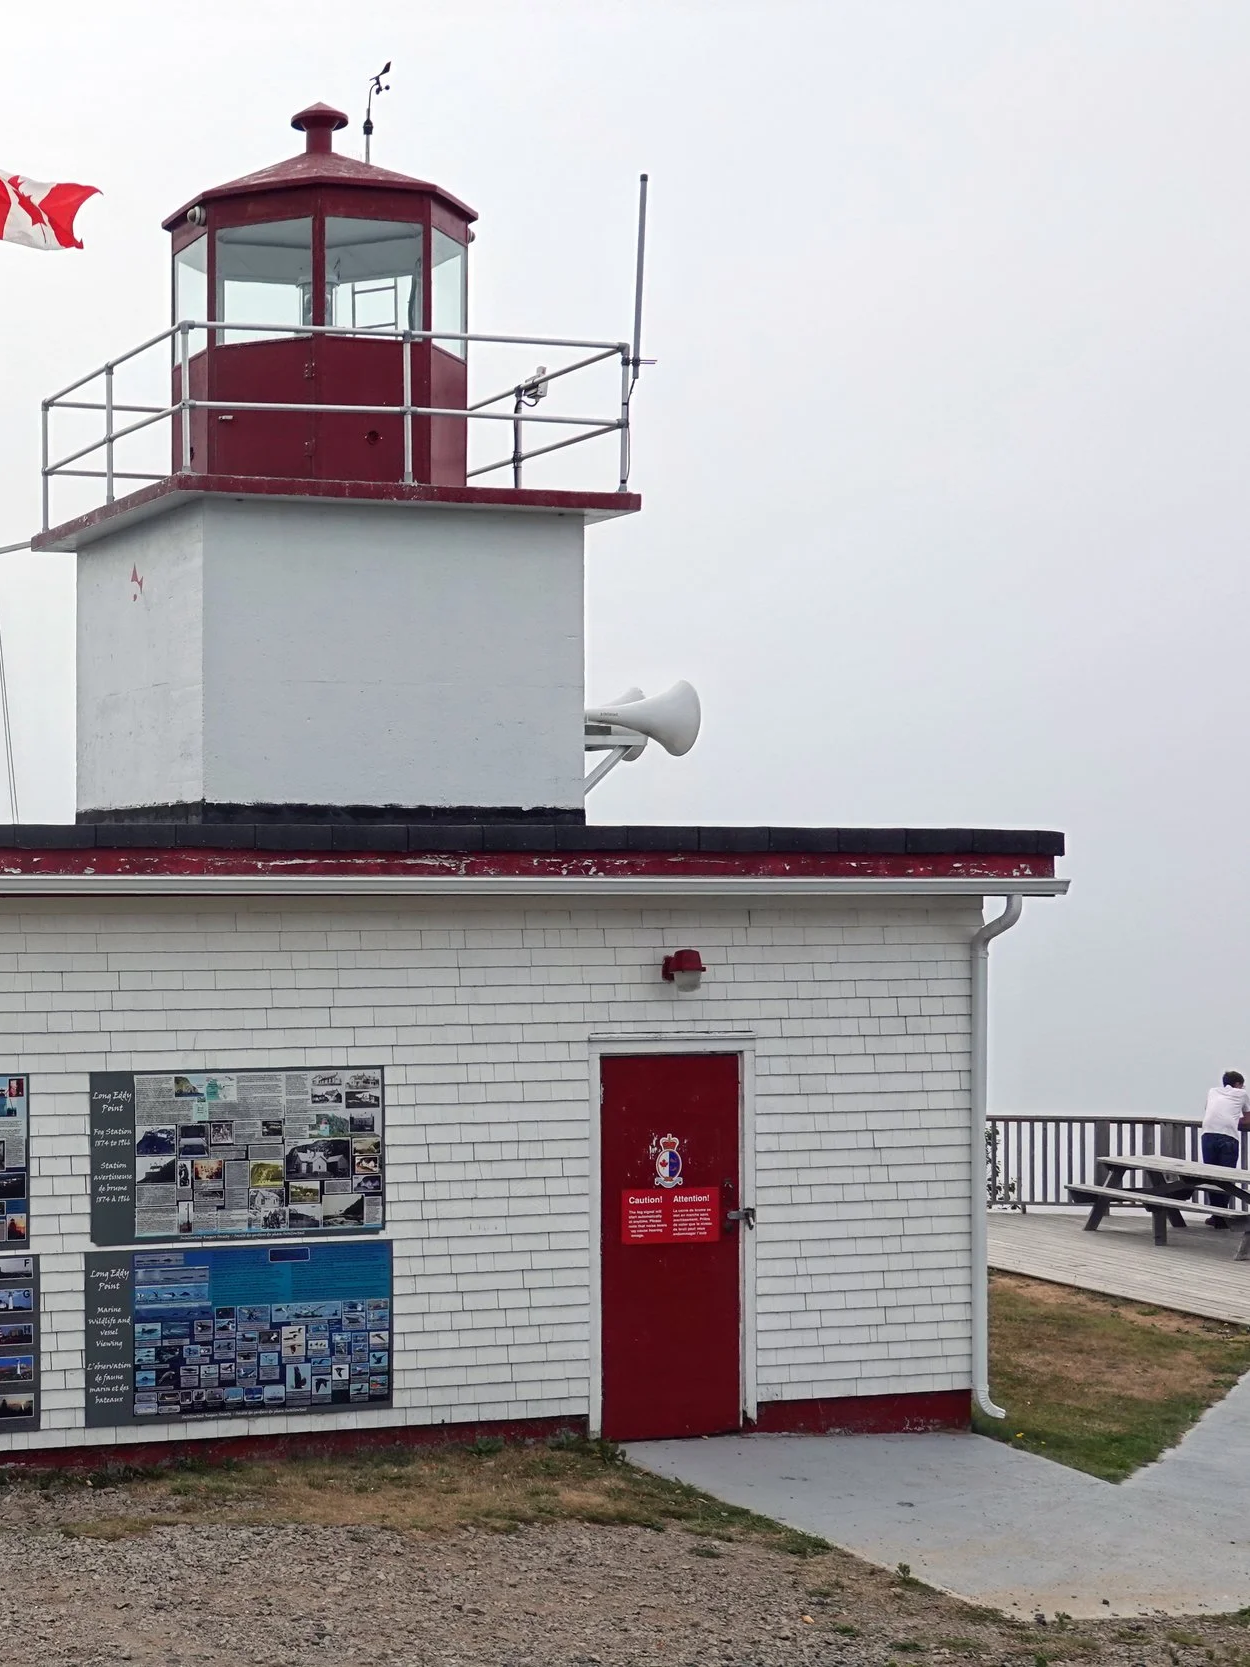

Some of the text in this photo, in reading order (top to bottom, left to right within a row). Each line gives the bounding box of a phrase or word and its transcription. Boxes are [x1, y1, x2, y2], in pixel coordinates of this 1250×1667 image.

[92, 1091, 132, 1104] Long Eddy
[102, 1103, 124, 1114] Point
[94, 1127, 132, 1139] Fog Station
[100, 1161, 127, 1169] Station
[94, 1173, 132, 1181] avertisseuse
[99, 1183, 128, 1194] de brume
[628, 1196, 663, 1204] Caution!
[673, 1194, 710, 1203] Attention!
[24, 1259, 30, 1267] F
[90, 1268, 129, 1282] Long Eddy
[98, 1282, 120, 1292] Point
[23, 1290, 30, 1298] G
[97, 1306, 122, 1314] Marine
[118, 1316, 132, 1325] and
[96, 1340, 123, 1350] Viewing
[87, 1362, 132, 1370] L'observation
[95, 1373, 123, 1385] de faune
[89, 1385, 111, 1393] marin
[120, 1384, 129, 1393] des
[95, 1396, 123, 1404] bateaux
